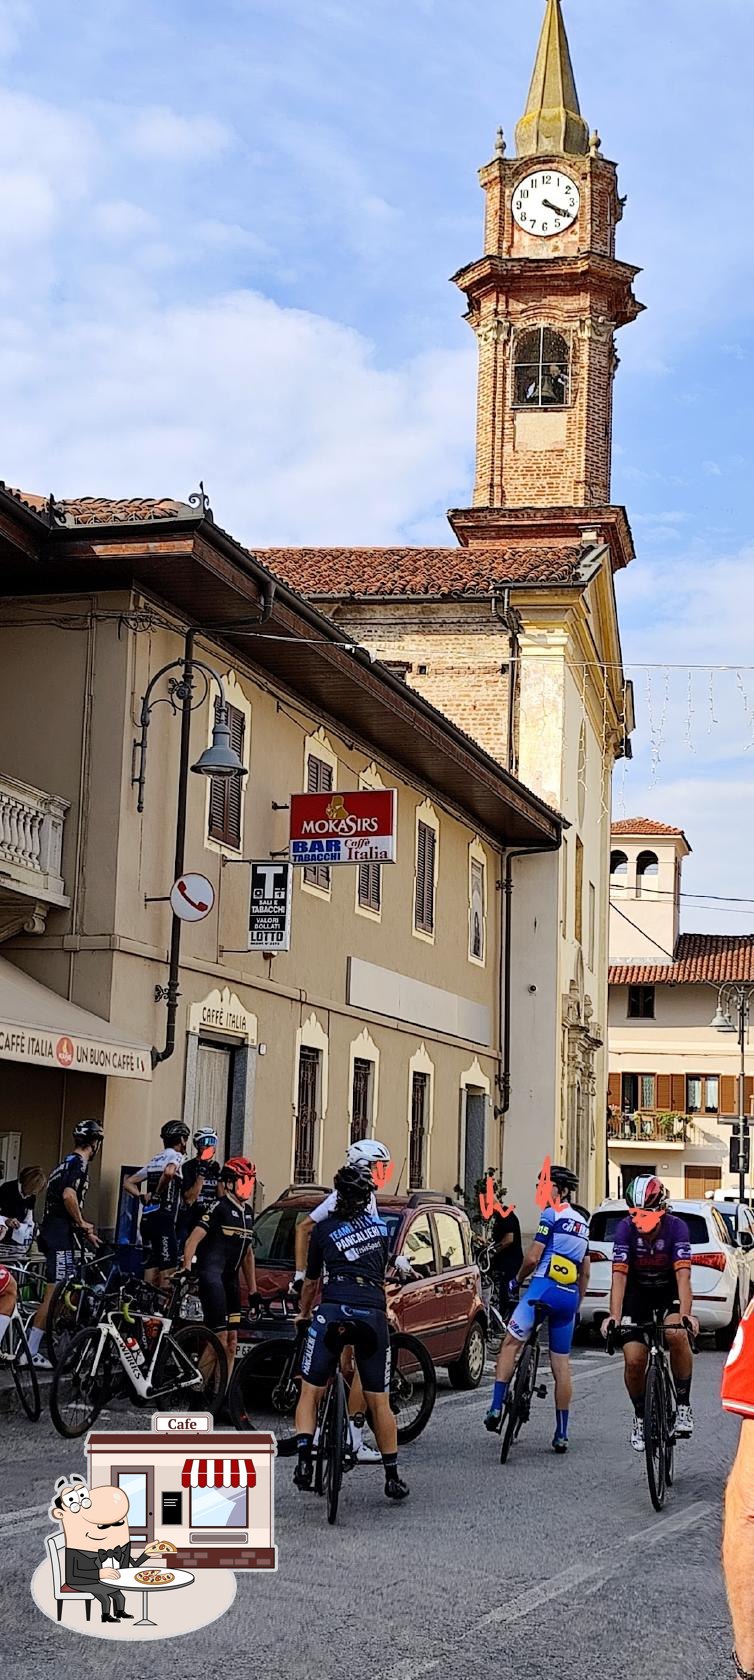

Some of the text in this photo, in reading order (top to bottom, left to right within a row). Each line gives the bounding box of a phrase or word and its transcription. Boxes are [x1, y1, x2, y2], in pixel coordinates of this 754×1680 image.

[531, 178, 537, 188] 11
[542, 175, 551, 184] 12
[520, 189, 529, 198] 10
[565, 185, 572, 194] 2
[516, 200, 522, 210] 9
[569, 197, 575, 207] 3
[520, 211, 527, 221] 8
[530, 219, 536, 229] 7
[542, 222, 548, 231] 6
[554, 218, 561, 228] 5
[301, 815, 379, 836] MOKASIRS
[292, 839, 341, 853] BAR
[344, 838, 370, 849] Caffè
[292, 852, 341, 862] TABACCHI
[347, 846, 388, 860] Italia
[256, 866, 283, 899] T
[251, 905, 285, 914] TABACCHI
[250, 931, 284, 942] LOTTO
[202, 1006, 247, 1031] CAFFÈ ITALIA
[27, 1036, 54, 1059] ITALIA
[76, 1045, 89, 1063] UN
[89, 1048, 111, 1067] BUON
[329, 1224, 352, 1242] TEAM
[335, 1225, 381, 1252] PANCALIERI
